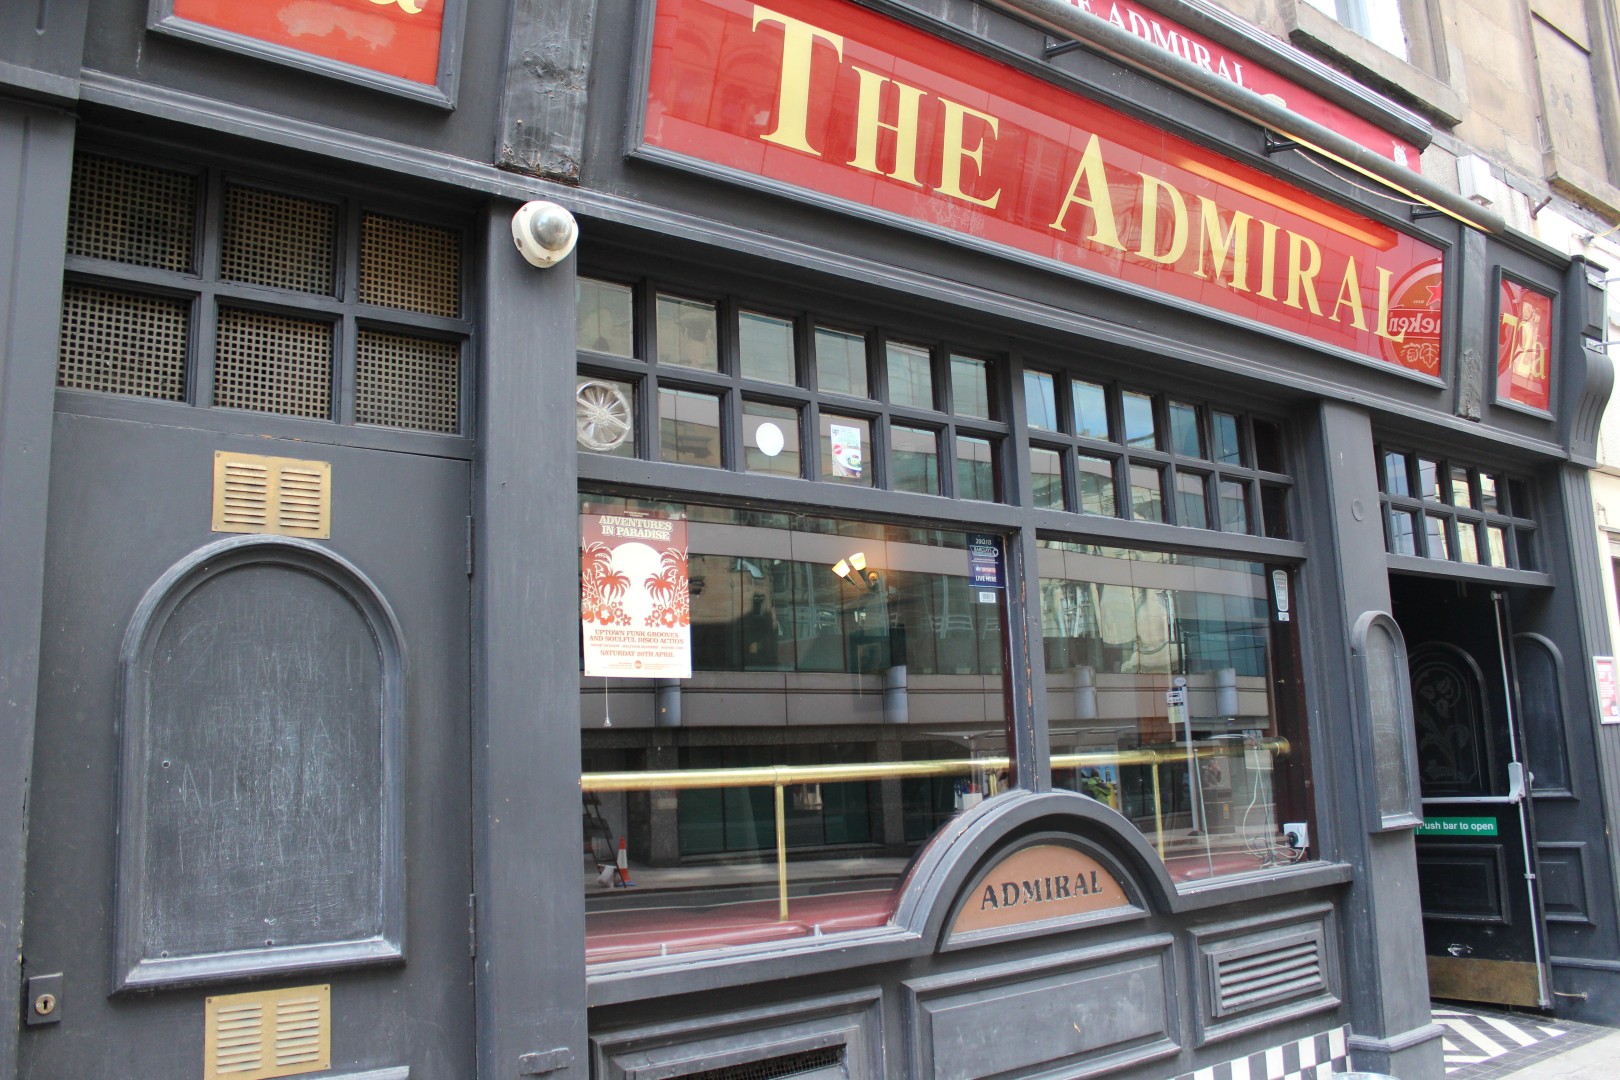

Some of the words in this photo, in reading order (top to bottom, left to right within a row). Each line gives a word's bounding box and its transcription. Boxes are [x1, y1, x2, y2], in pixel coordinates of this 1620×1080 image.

[1108, 1, 1254, 92] ADMIRAL
[752, 4, 1002, 210] THE
[1048, 133, 1406, 344] ADMIRAL
[599, 515, 673, 533] ADVENTURES
[601, 526, 616, 537] IN
[616, 526, 671, 542] PARADISE
[600, 649, 636, 657] SATURDAY
[1442, 821, 1457, 830] bar
[1459, 822, 1469, 830] to
[1470, 822, 1494, 832] open
[981, 870, 1103, 911] ADMIRAL
